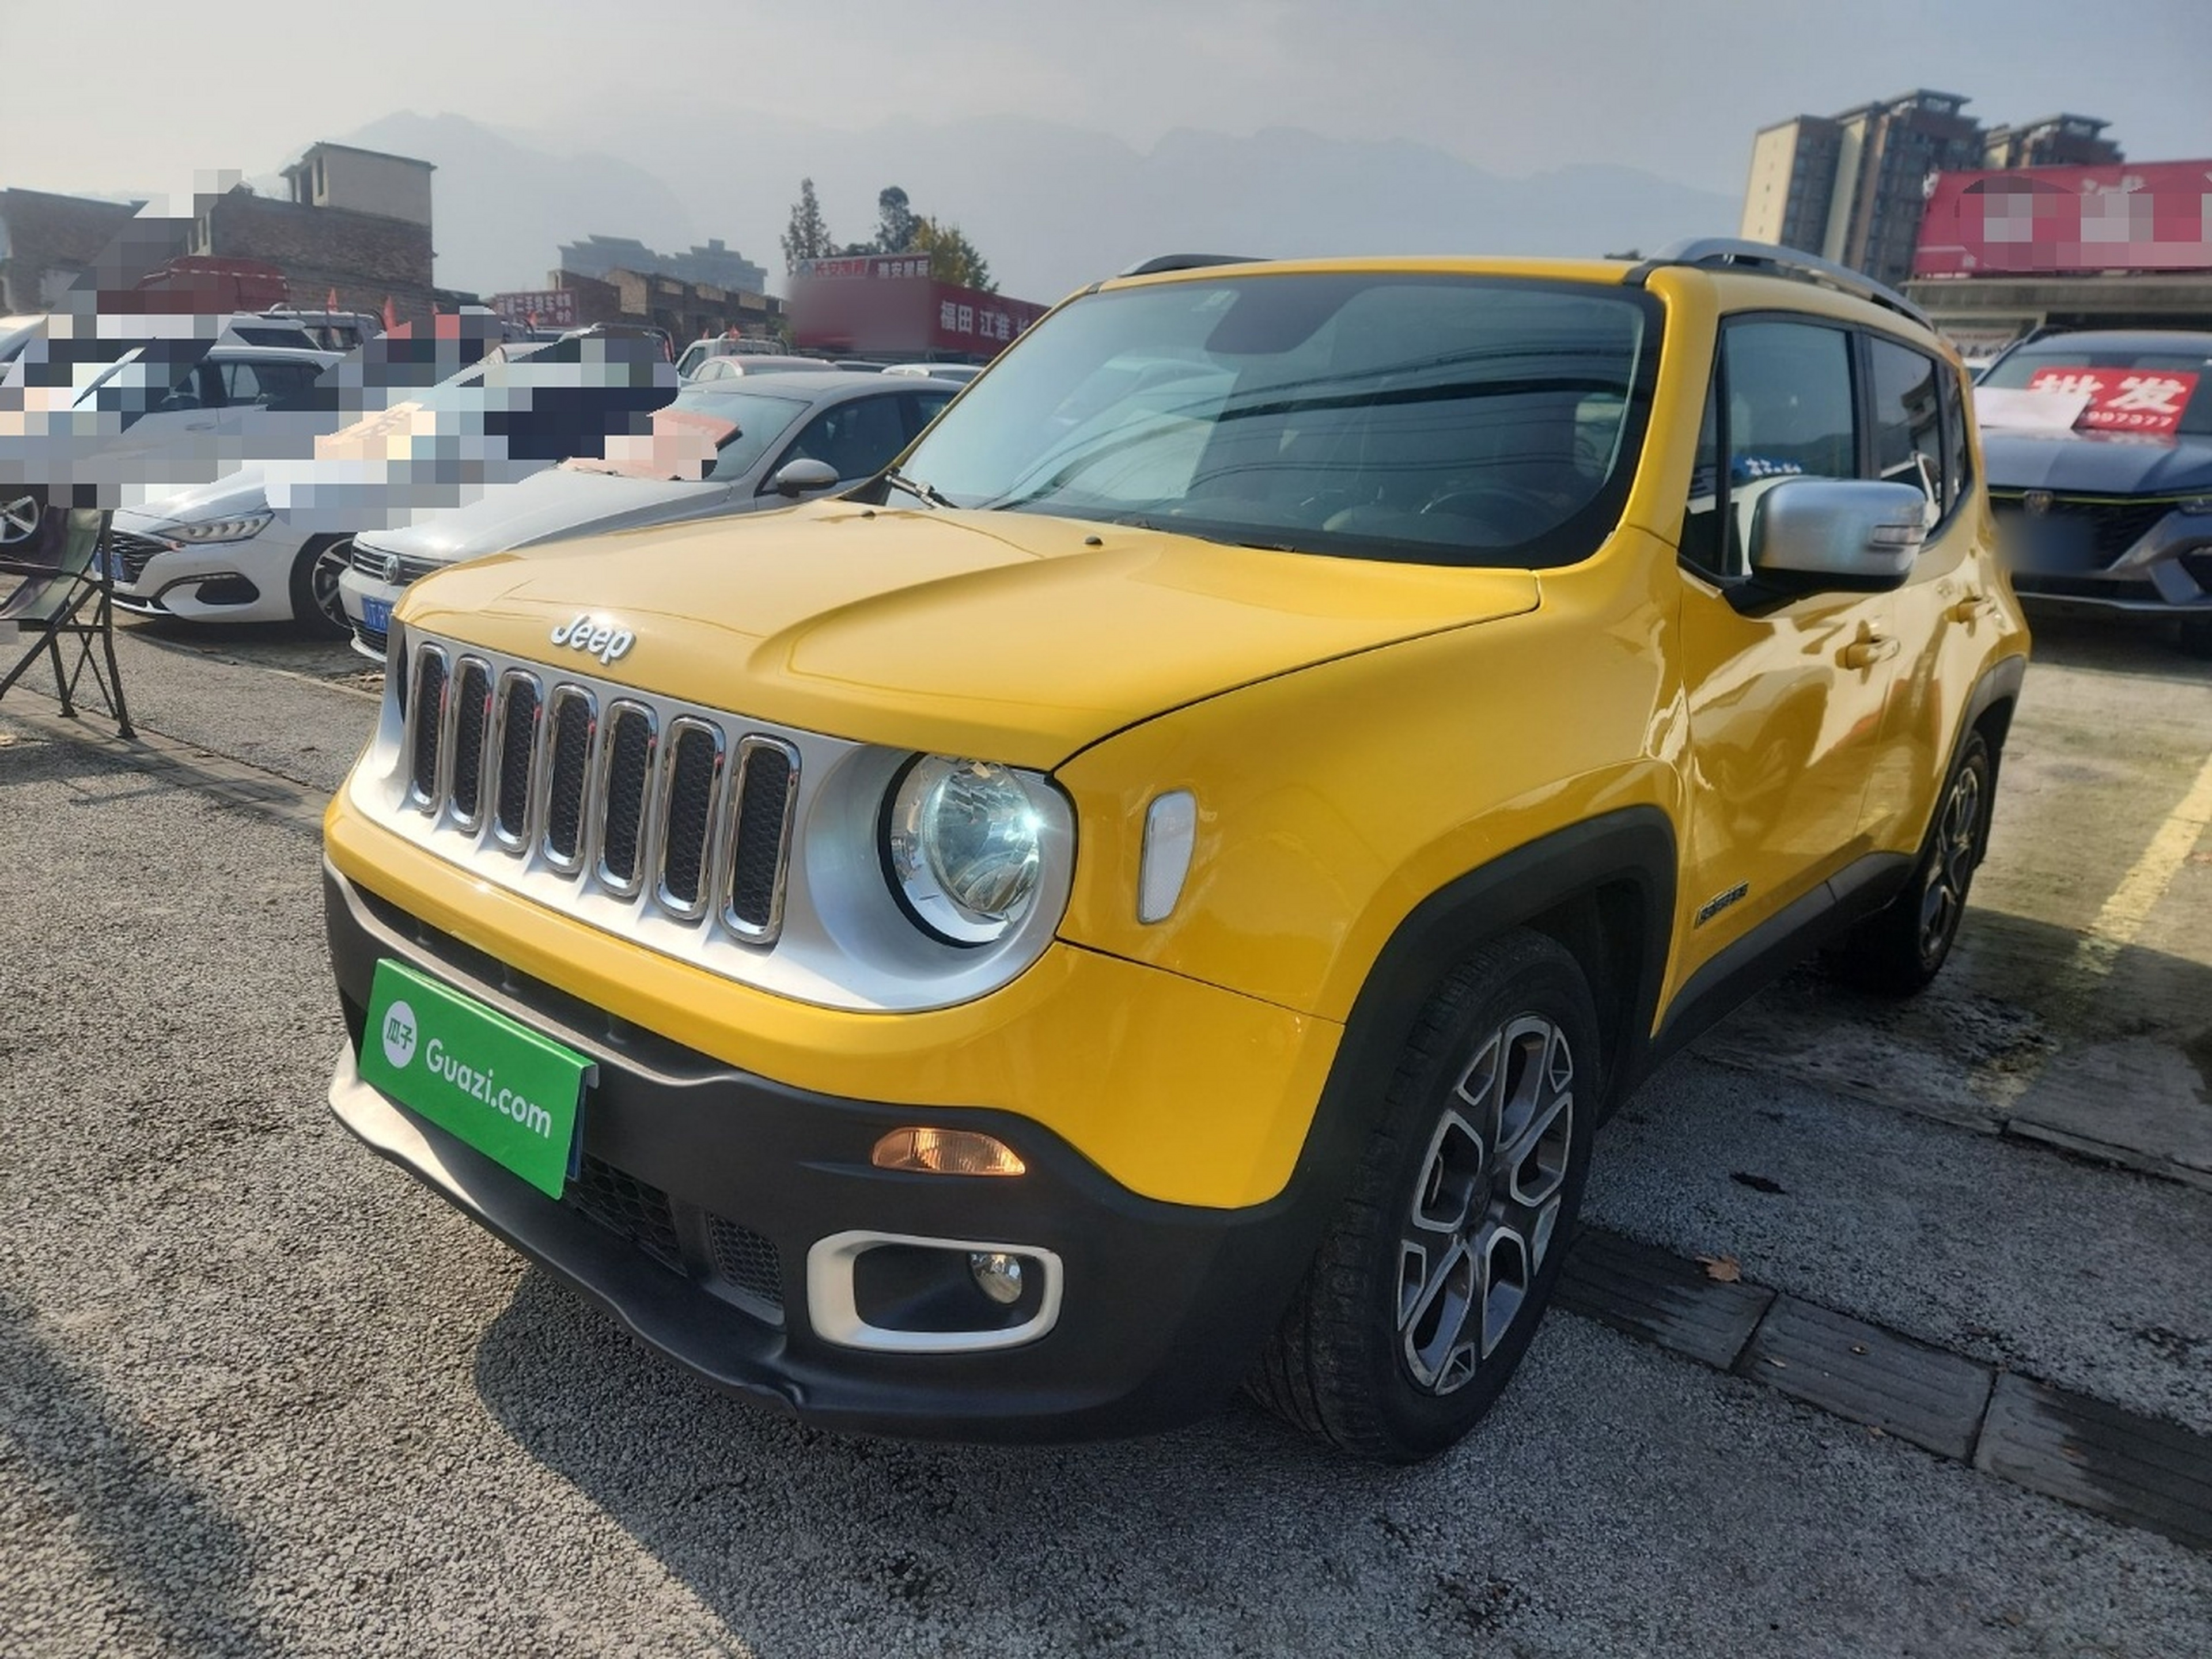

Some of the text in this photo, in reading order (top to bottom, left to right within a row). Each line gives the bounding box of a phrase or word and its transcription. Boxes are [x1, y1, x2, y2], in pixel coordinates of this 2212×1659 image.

[941, 300, 973, 335] 福田
[980, 310, 1010, 340] 江淮
[2031, 374, 2187, 414] 批发
[550, 613, 636, 666] Jeep
[387, 1017, 413, 1050] 瓜子
[426, 1038, 552, 1139] Guazi.com
